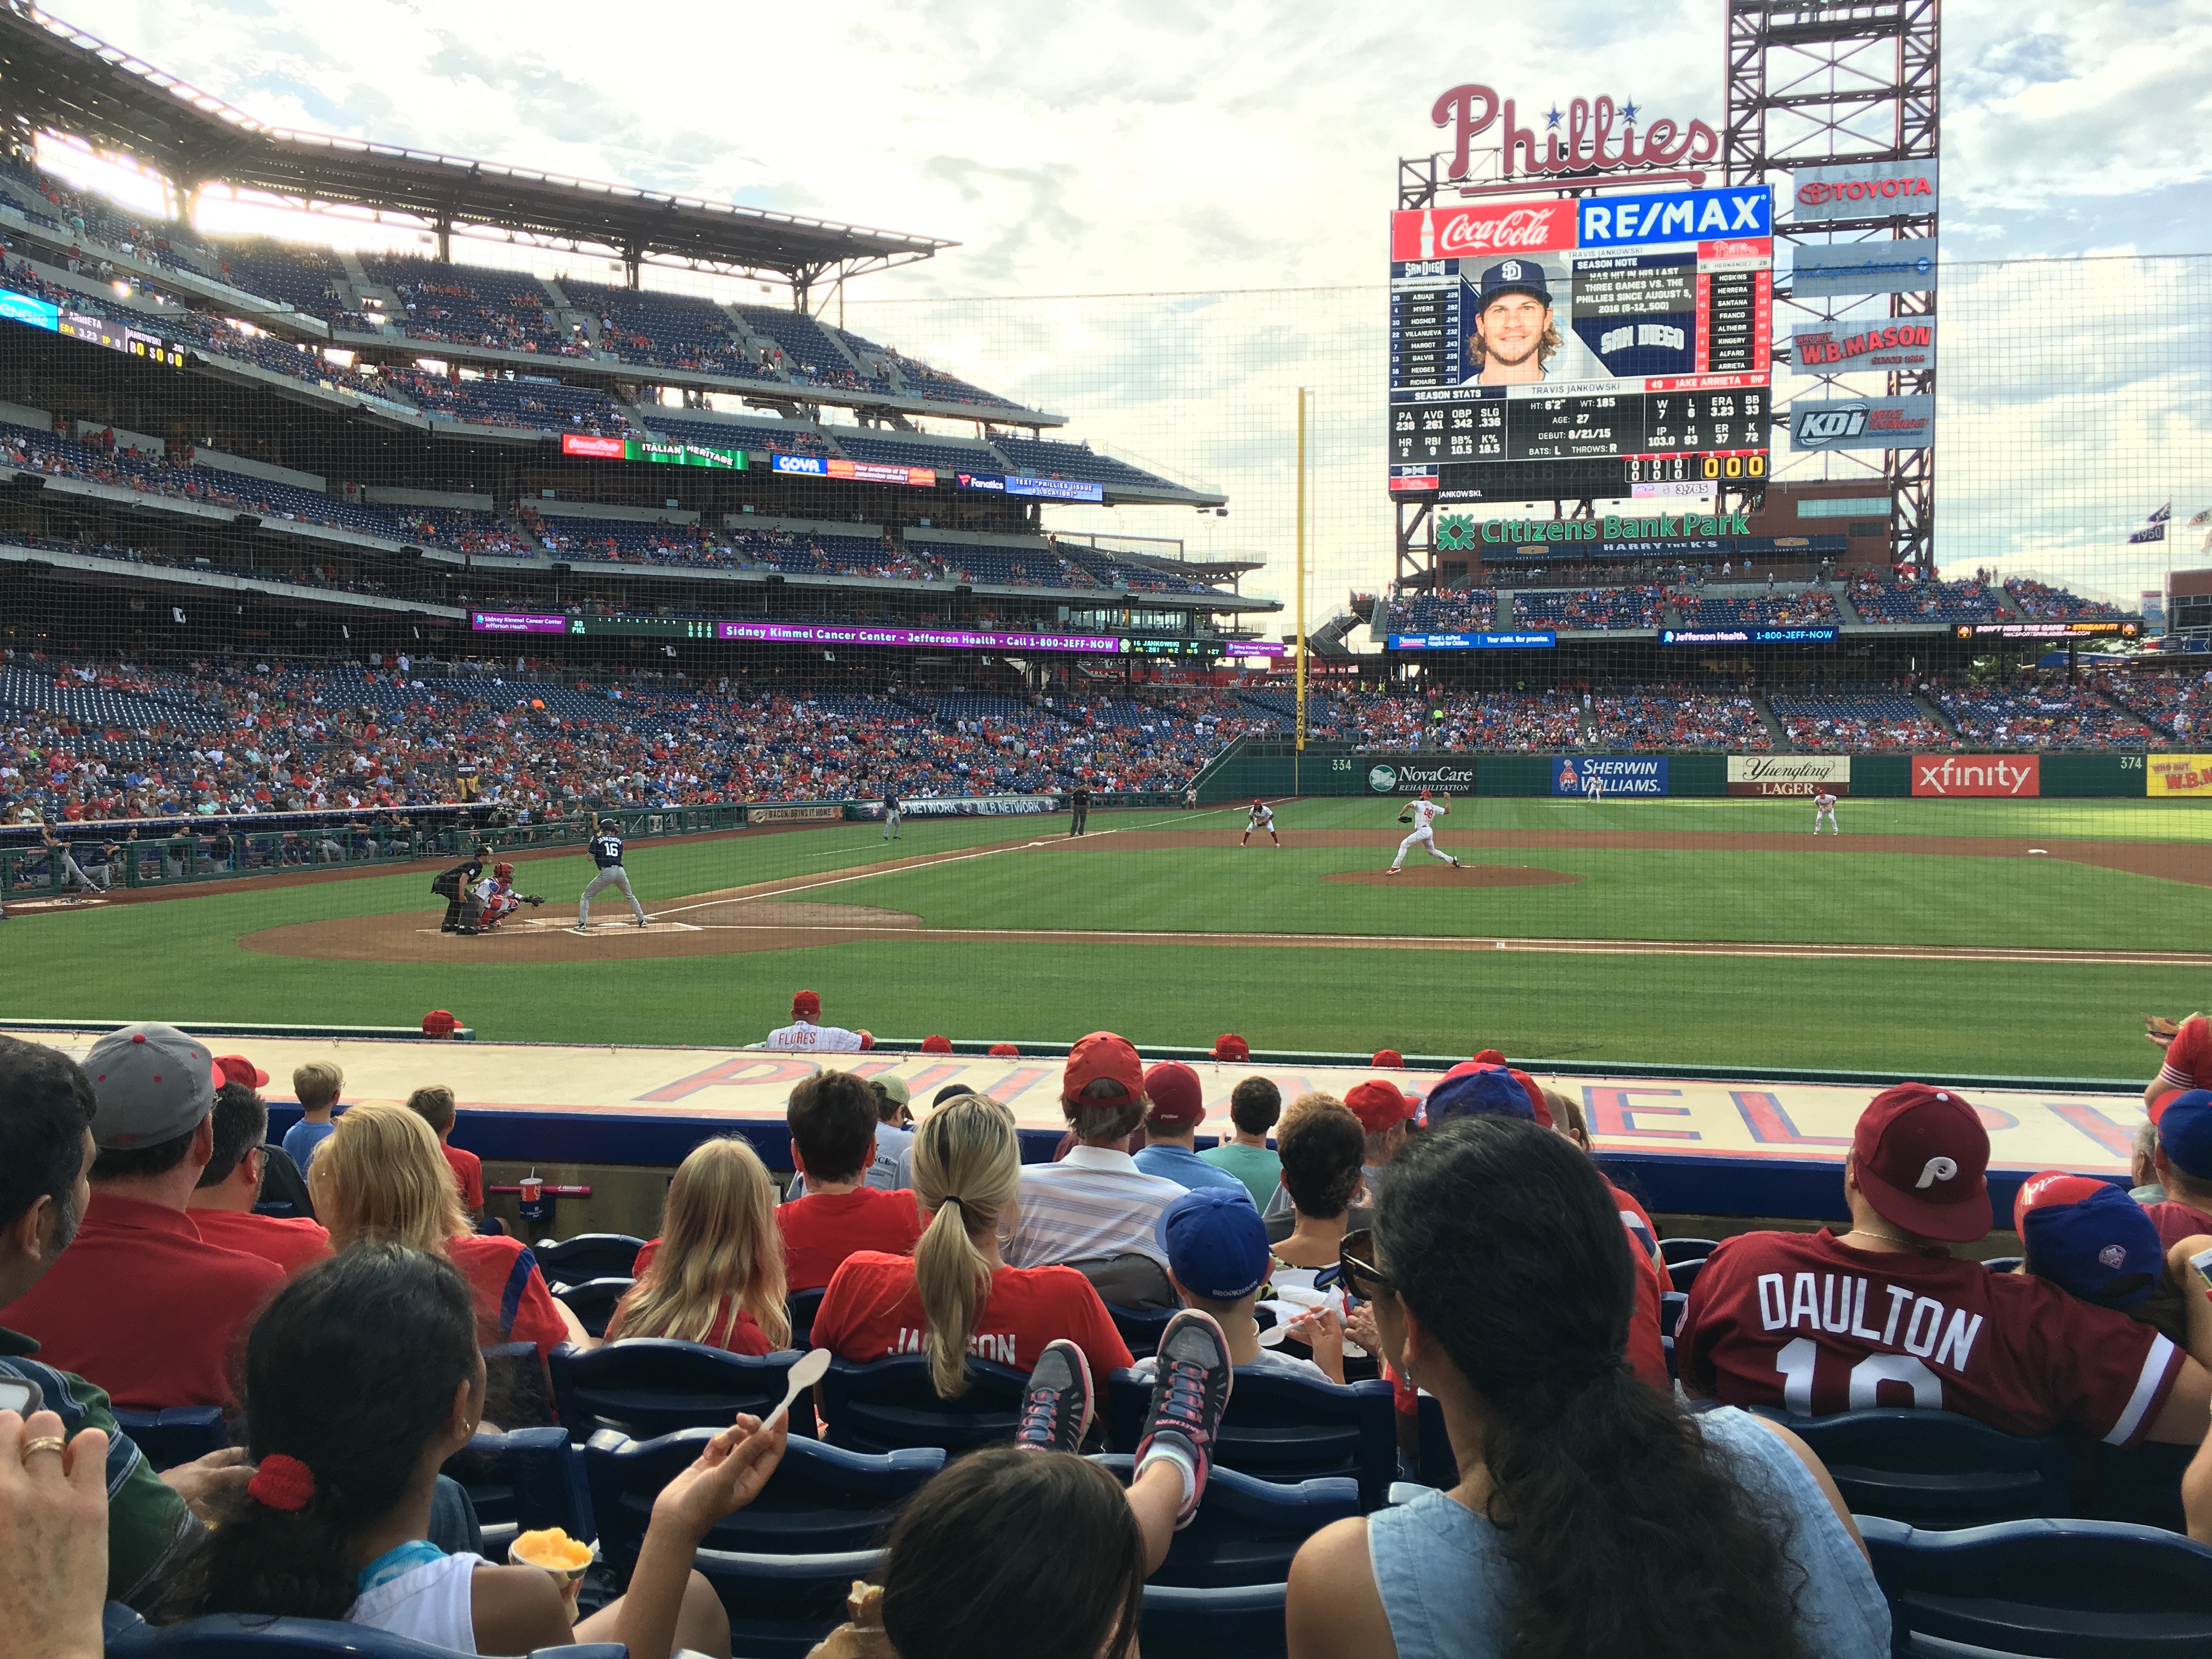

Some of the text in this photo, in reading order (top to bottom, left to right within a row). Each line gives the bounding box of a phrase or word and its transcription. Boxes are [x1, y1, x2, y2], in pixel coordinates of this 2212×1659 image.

[1430, 81, 1719, 180] Phillies
[1832, 177, 1932, 200] TOYOTA
[1585, 195, 1760, 240] RE/MAX
[1441, 206, 1557, 250] Coca-Cola
[1598, 247, 1643, 258] JANKOWSKI
[1713, 240, 1758, 257] Phillies
[1406, 260, 1445, 278] SAN DIEGO
[1577, 258, 1638, 269] SEASON NOTE
[1585, 278, 1684, 292] THREE GAMES VS. THE
[1576, 290, 1681, 304] PHILLIES SINCE AUGUST
[1598, 304, 1620, 313] 2016
[60, 323, 98, 342] ERA 3.23
[127, 329, 162, 347] JANKOWSKI
[1601, 324, 1684, 354] SAN DIEGO
[1797, 334, 1831, 344] WHO BUT
[1871, 356, 1902, 364] SINCE
[1675, 375, 1764, 389] JAKE ARRIETA RHP
[1414, 390, 1481, 400] SEASON STATS
[1532, 384, 1620, 394] TRAVIS JANKOWSKI
[1545, 399, 1566, 410] 6'2"
[1596, 398, 1616, 408] 185
[1711, 396, 1733, 406] ERA
[1423, 408, 1499, 420] AVG OBP SLG
[1711, 407, 1734, 416] 3.23
[1423, 417, 1501, 430] .261 .342 .336
[1568, 428, 1611, 439] 8/21/15
[1425, 436, 1472, 445] RBI BB%
[1648, 436, 1675, 447] 103.0
[642, 443, 733, 466] ITALIAN HERITAGE
[1451, 444, 1500, 454] 10.5 18.5
[780, 457, 820, 472] GOYA
[971, 476, 1003, 490] Fanatics
[1675, 483, 1708, 495] 3,765
[1482, 508, 1750, 543] Citizens Bank Park
[2137, 527, 2161, 541] 1950
[1604, 542, 1662, 551] HARRY
[726, 626, 1113, 649] Sidney Kimmel Cancer Center Jefferson Health Call 1-800-JEFF-NOW
[1675, 631, 1833, 641] Jefferson Health. 1-800-JEFF-NOW
[1333, 759, 1351, 770] 334
[1582, 759, 1657, 776] SHERWIN
[1743, 757, 1835, 781] Yuengling
[2120, 757, 2142, 769] 374
[2152, 764, 2171, 772] WHO
[1398, 766, 1472, 781] NovaCare
[1920, 759, 2032, 793] xfinity
[1762, 782, 1814, 794] LAGER
[769, 808, 833, 818] BACON. BRING IT HOME.
[907, 802, 957, 814] NETWORK
[978, 802, 997, 814] MLB
[998, 802, 1041, 814] NETWORK
[1424, 808, 1434, 819] 49
[605, 843, 618, 856] 16
[779, 1032, 816, 1045] FLORES
[1916, 1155, 1958, 1189] P
[1212, 1279, 1258, 1297] BROOKHAVEN
[1758, 1272, 1985, 1373] DAULTON
